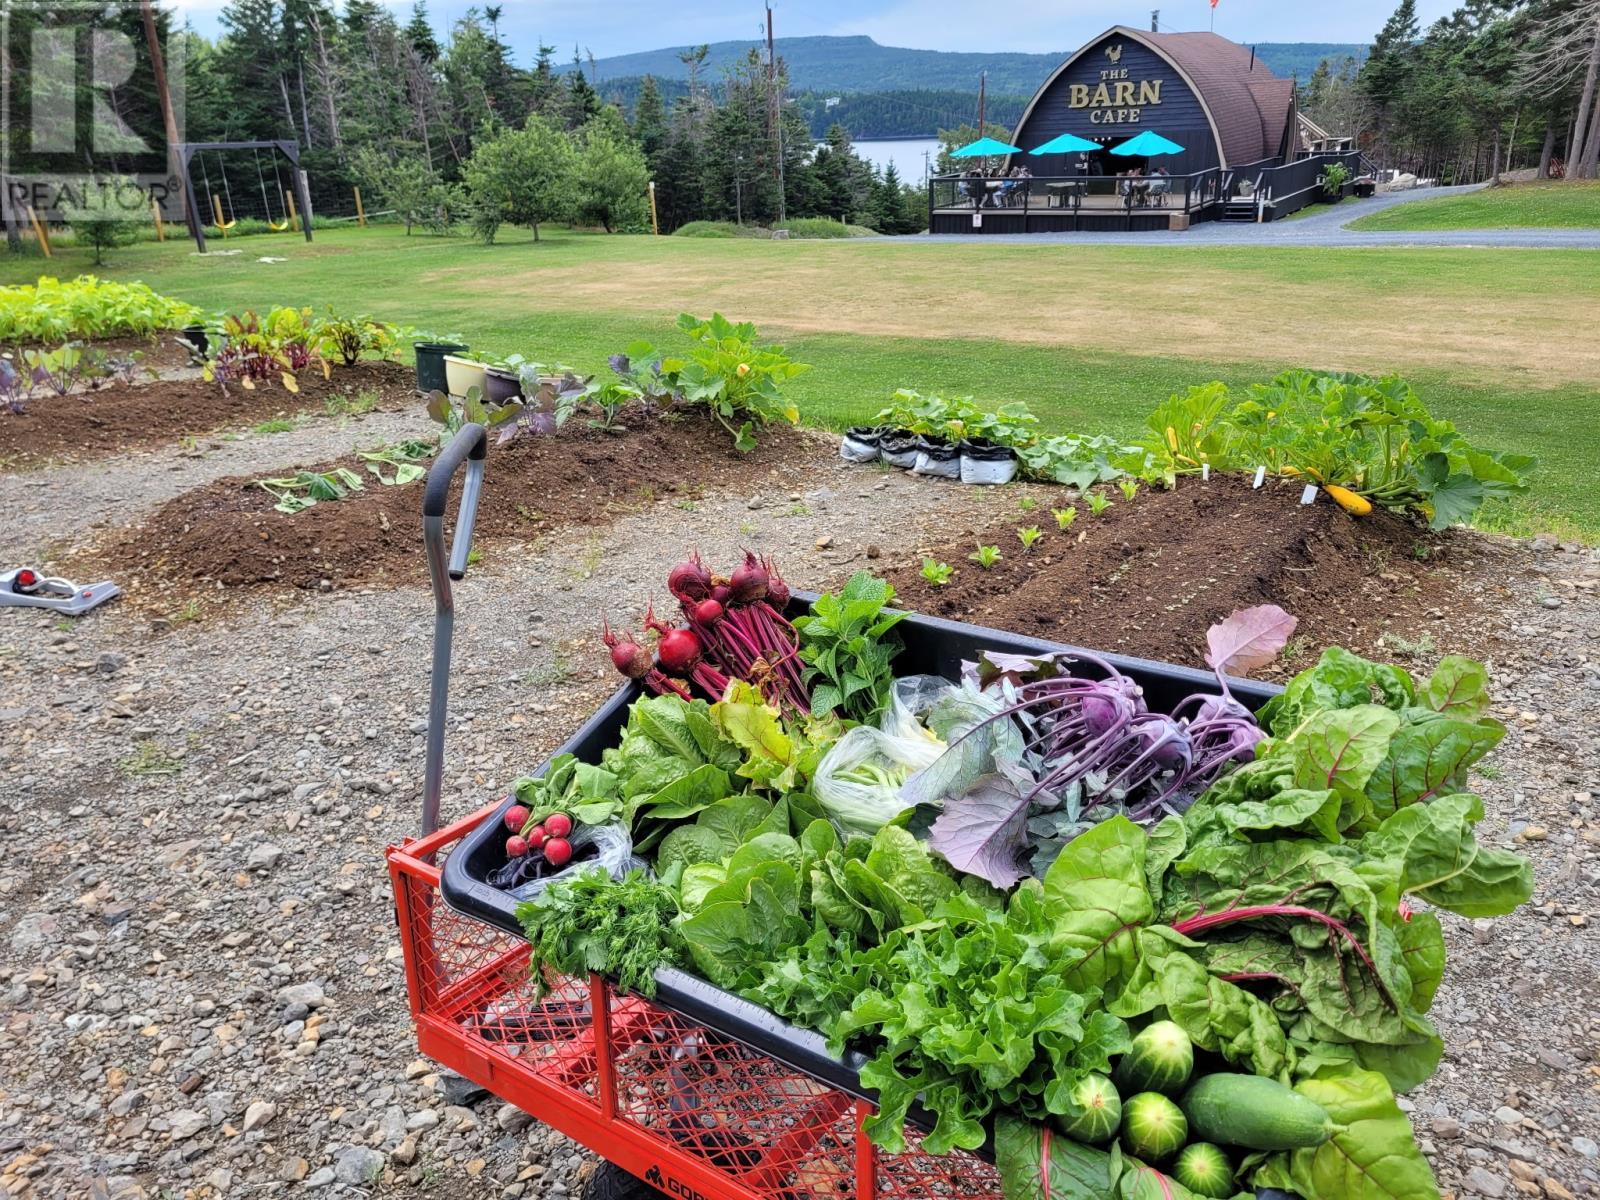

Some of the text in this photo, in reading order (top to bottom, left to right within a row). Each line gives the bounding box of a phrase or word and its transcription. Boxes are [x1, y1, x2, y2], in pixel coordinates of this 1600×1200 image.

[1100, 68, 1128, 80] THE
[1068, 79, 1163, 109] BARN
[1090, 109, 1140, 124] CAFE
